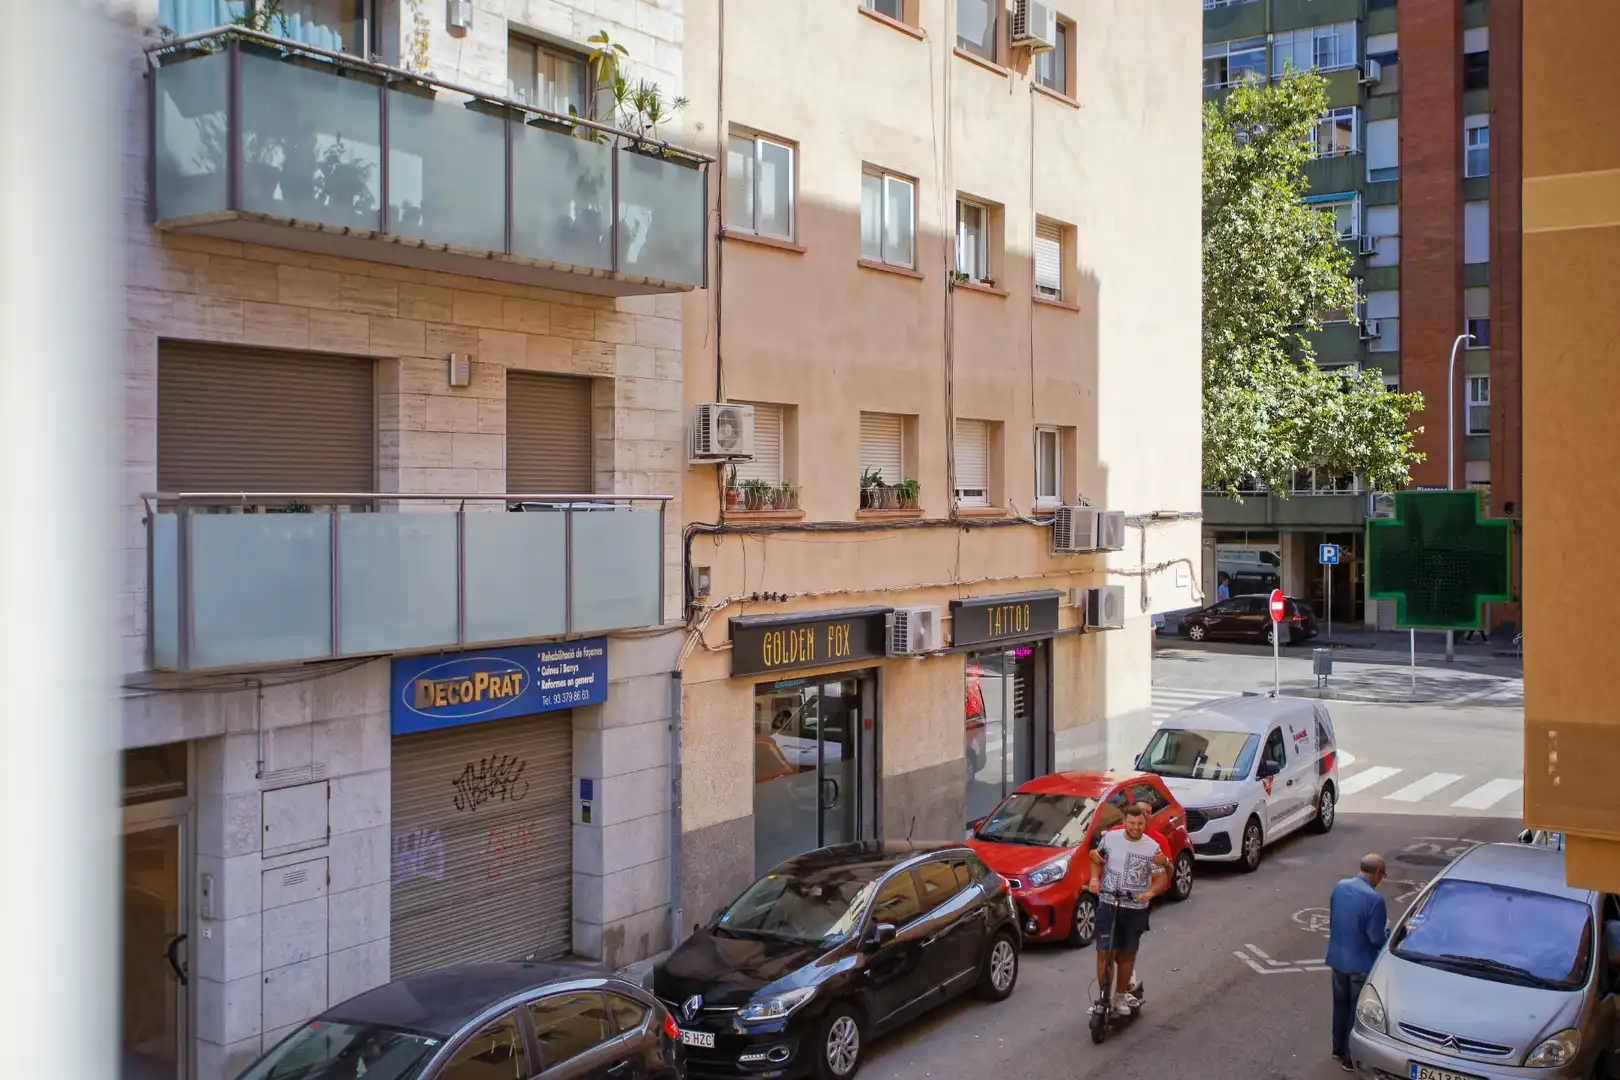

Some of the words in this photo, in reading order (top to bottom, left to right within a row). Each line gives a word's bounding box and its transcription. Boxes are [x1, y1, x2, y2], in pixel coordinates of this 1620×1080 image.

[1323, 547, 1335, 561] P
[987, 604, 1030, 636] TATTOO
[763, 627, 815, 667] GOLDEN
[828, 624, 851, 658] FOX
[541, 665, 559, 676] Cuines
[563, 664, 579, 675] Banys
[541, 678, 566, 690] Reformes
[575, 672, 595, 688] general
[693, 1032, 712, 1046] HZC
